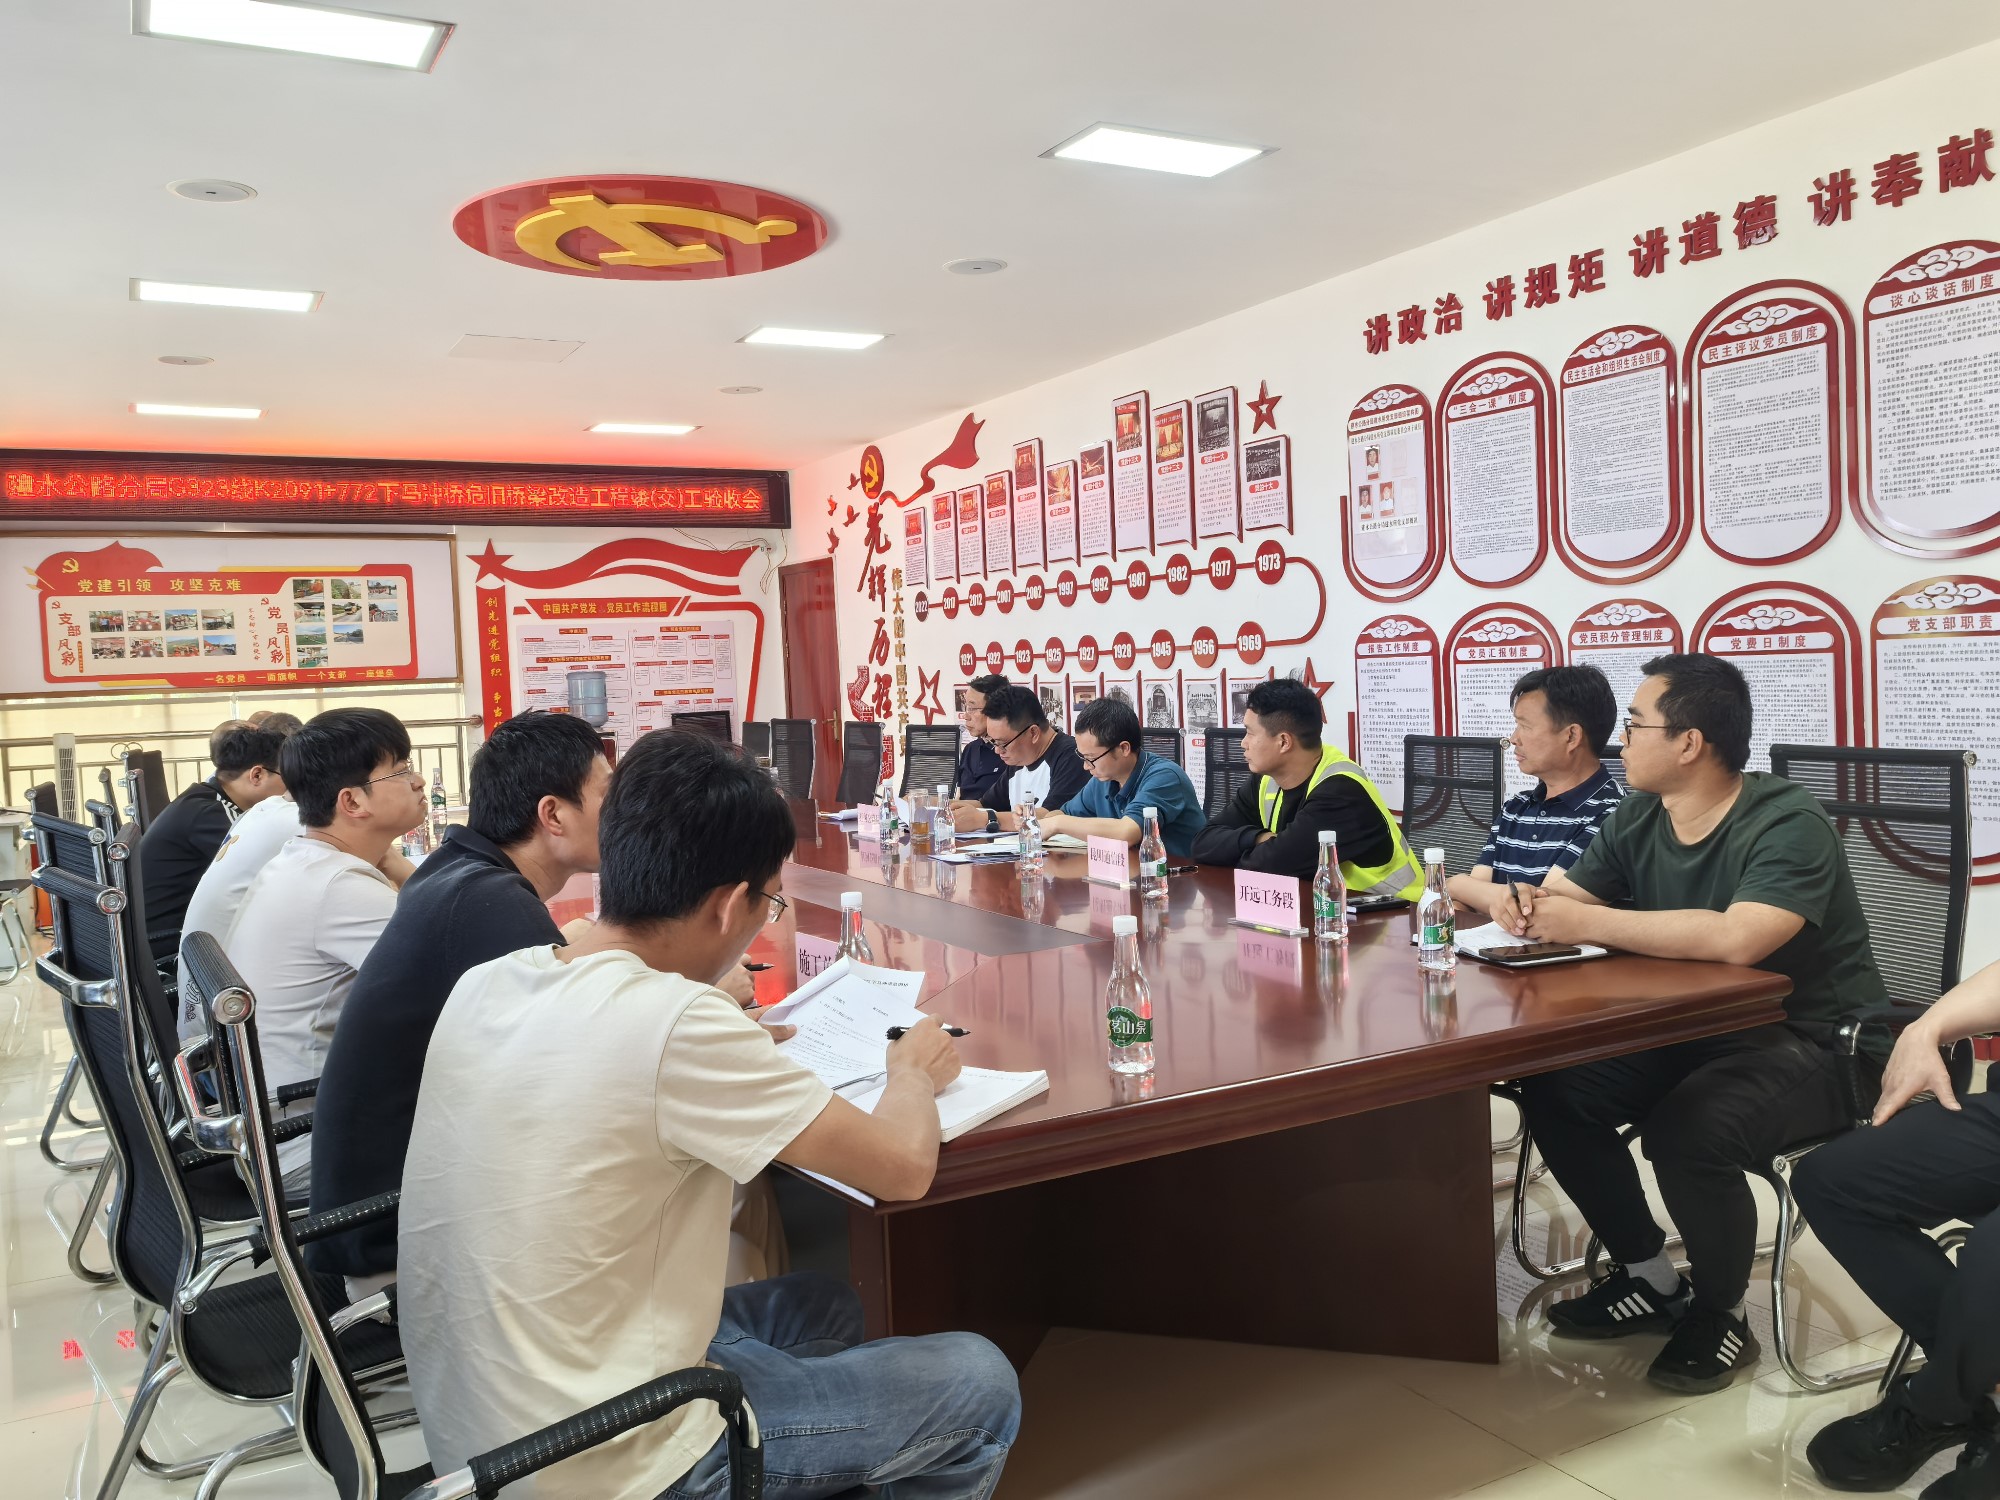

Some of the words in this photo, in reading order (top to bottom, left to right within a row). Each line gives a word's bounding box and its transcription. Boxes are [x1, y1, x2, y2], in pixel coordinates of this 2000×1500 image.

[1363, 293, 1464, 355] 讲政治
[1482, 248, 1606, 321] 讲规矩
[1629, 194, 1780, 278] 讲道德
[1807, 128, 1997, 226] 讲奉献
[1890, 273, 1994, 308] 谈心谈话制度
[1708, 325, 1818, 361] 民主评议党员制度
[1567, 349, 1661, 382] 民主生活会和组织生活会制度
[1210, 559, 1231, 577] 1977
[1257, 552, 1281, 571] 1973
[1128, 572, 1146, 588] 1987
[1167, 565, 1188, 582] 1982
[78, 579, 152, 593] 党建引领
[170, 578, 242, 592] 攻坚克难
[1058, 581, 1074, 595] 1997
[1091, 577, 1109, 592] 1992
[996, 590, 1011, 604] 2007
[1026, 585, 1042, 600] 2002
[543, 602, 598, 615] 中国共产党发
[606, 601, 668, 614] 党员工作流程图
[915, 600, 929, 613] 2022
[943, 597, 956, 609] 2017
[969, 594, 983, 607] 2012
[857, 502, 892, 719] 光辉历程
[1908, 615, 1993, 632] 党支部职责
[58, 612, 82, 666] 支部风彩
[267, 606, 289, 664] 党员风彩
[485, 596, 502, 677] 创先进党组织
[1237, 634, 1262, 651] 1969
[1579, 629, 1664, 644] 党员积分管理制度
[1731, 635, 1806, 650] 党费日制度
[1078, 646, 1095, 661] 1927
[1113, 643, 1132, 658] 1928
[1152, 640, 1172, 657] 1945
[1193, 638, 1215, 655] 1956
[1367, 642, 1419, 654] 报告工作制度
[1468, 646, 1528, 659] 党员汇报制度
[960, 653, 974, 666] 1921
[986, 651, 1001, 665] 1922
[1015, 650, 1031, 663] 1923
[1045, 648, 1062, 662] 1925
[204, 674, 247, 684] 一名党员
[256, 672, 298, 682] 一面旗帜
[306, 670, 347, 680] 一个支部
[1090, 847, 1125, 867] 昆明通信段
[1240, 884, 1294, 910] 开远工务段
[1112, 1019, 1147, 1035] 茗山泉
